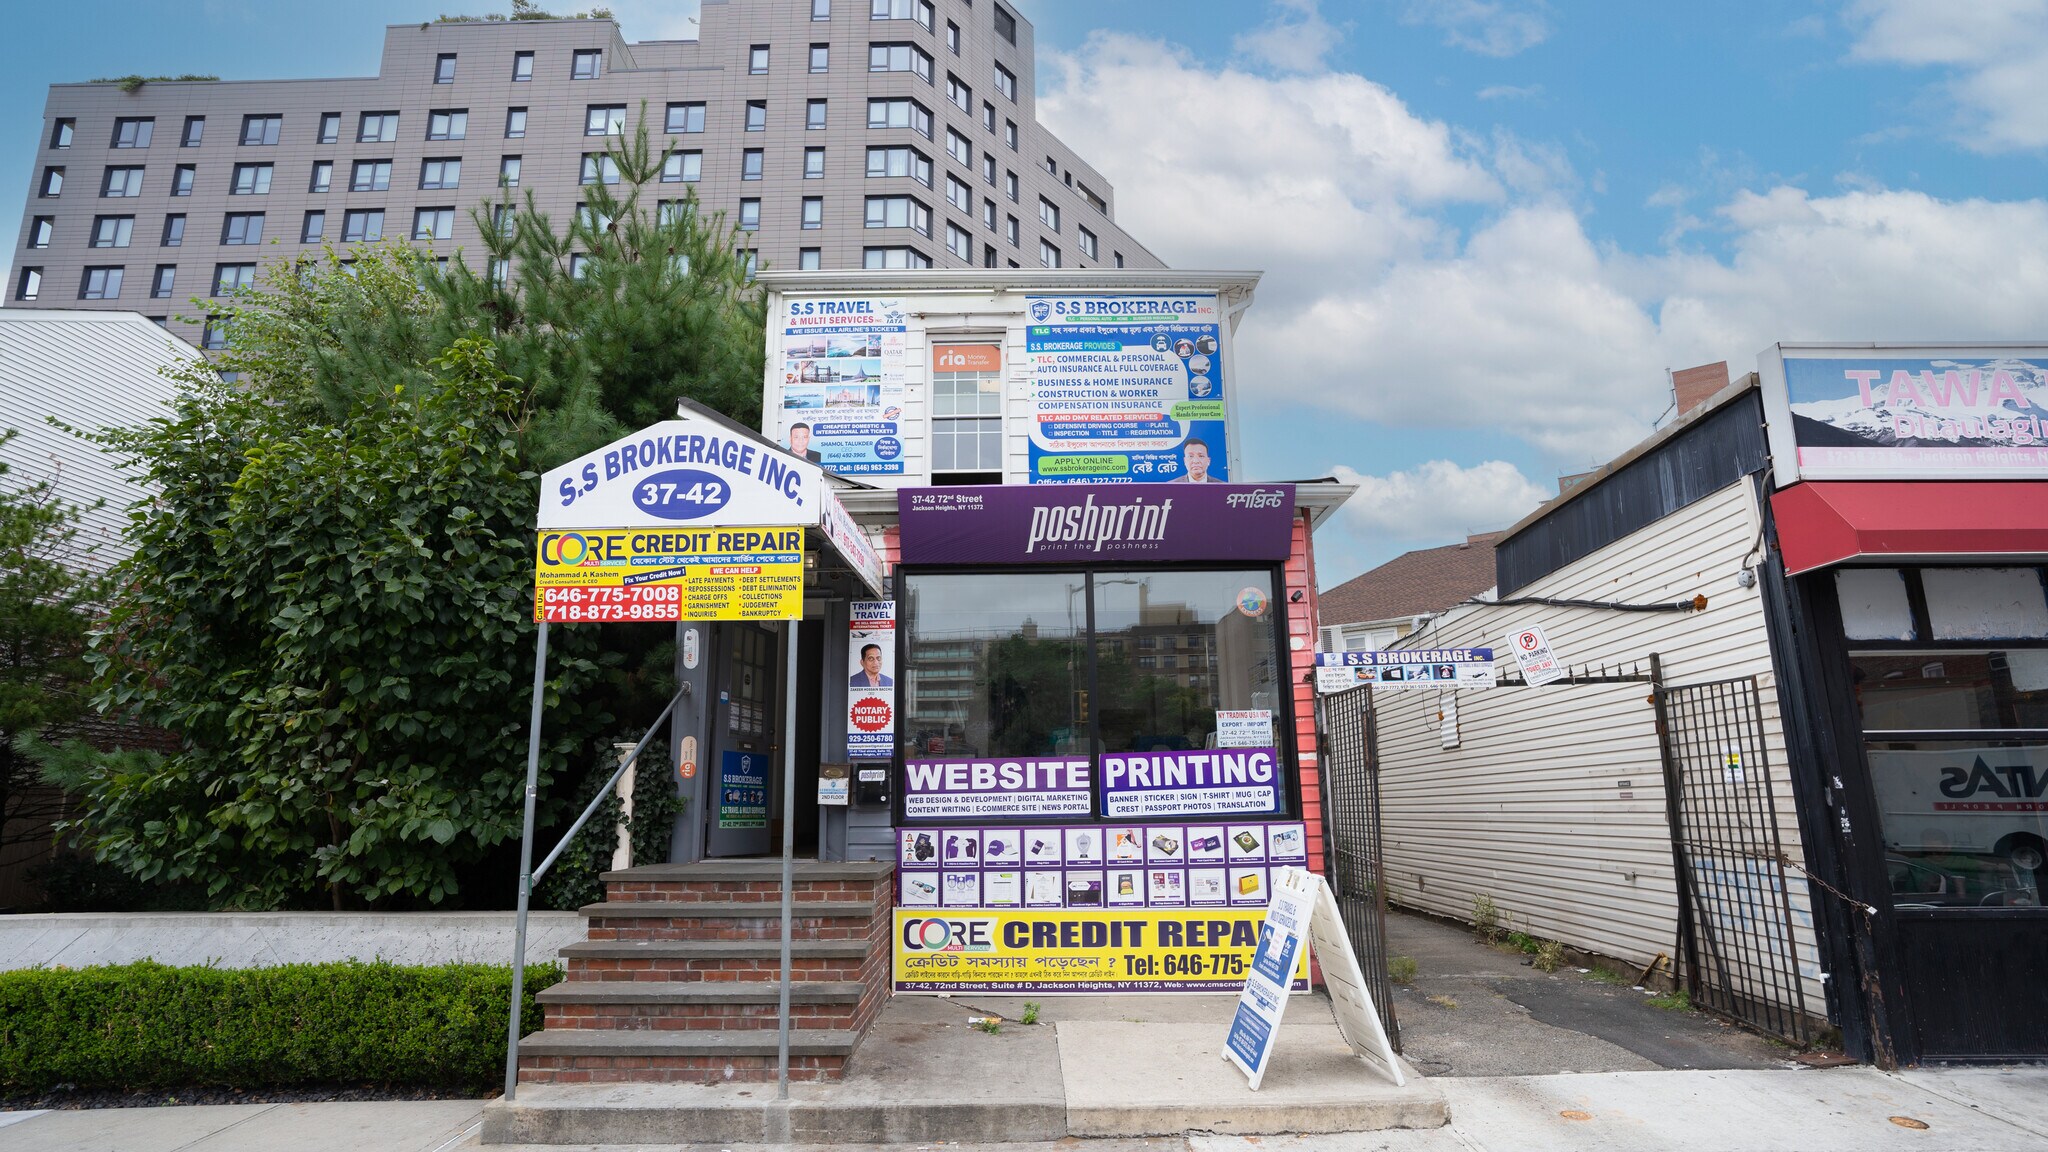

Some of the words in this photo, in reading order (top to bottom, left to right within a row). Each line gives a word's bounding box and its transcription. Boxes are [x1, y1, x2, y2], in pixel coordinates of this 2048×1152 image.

[791, 302, 814, 315] S.S
[818, 301, 873, 314] TRAVEL
[1055, 301, 1081, 315] S.S
[1085, 300, 1197, 314] BROKERAGE
[800, 316, 826, 325] MULTI
[829, 315, 874, 324] SERVICES
[1045, 342, 1083, 350] BROKERAGE
[1084, 342, 1115, 350] PROVIDES
[940, 350, 965, 366] ria
[1057, 355, 1111, 363] COMMERCIAL
[1121, 354, 1165, 362] PERSONAL
[1037, 365, 1057, 373] AUTO
[1059, 365, 1103, 373] INSURANCE
[1104, 364, 1118, 372] ALL
[1120, 364, 1138, 372] FULL
[1139, 363, 1179, 371] COVERAGE
[1037, 379, 1082, 387] BUSINESS
[1093, 378, 1119, 386] HOME
[1121, 377, 1173, 386] INSURANCE
[1038, 390, 1109, 398] CONSTRUCTION
[1119, 389, 1158, 397] WORKER
[1845, 369, 2031, 408] TAWA
[1038, 402, 1109, 410] COMPENSATION
[1111, 401, 1163, 409] INSURANCE
[559, 462, 599, 507] S.S
[604, 434, 751, 482] BROKERAGE
[757, 452, 804, 507] INC.
[1042, 464, 1127, 473] www.ssbrokerageinc.com
[641, 482, 722, 504] 37-42
[911, 495, 935, 504] 37-42
[937, 494, 955, 503] 72nd
[956, 494, 983, 503] Street
[935, 504, 957, 512] Heights,
[1025, 494, 1173, 553] poshprint
[541, 533, 628, 567] CORE
[631, 533, 711, 553] CREDIT
[717, 532, 801, 552] REPAIR
[1040, 542, 1069, 552] print
[1073, 542, 1091, 550] the
[1106, 542, 1160, 552] poshness
[545, 586, 679, 602] 646-775-7008
[852, 602, 893, 610] TRIPWAY
[544, 604, 679, 620] 718-873-9855
[1347, 653, 1373, 665] S.S
[1376, 650, 1473, 664] BROKERAGE
[1528, 647, 1548, 658] PARKING
[906, 761, 1090, 790] WEBSITE
[1105, 752, 1273, 788] PRINTING
[1046, 794, 1088, 802] MARKETING
[1144, 794, 1175, 802] STICKER
[1180, 793, 1198, 801] SIGN
[1203, 792, 1230, 800] T-SHIRT
[1062, 803, 1089, 811] PORTAL
[1145, 804, 1182, 812] PASSPORT
[1217, 801, 1266, 809] TRANSLATION
[903, 918, 992, 949] CORE
[1003, 921, 1148, 949] CREDIT
[1158, 920, 1265, 947] REPA
[905, 953, 960, 968] ক্রেডিট
[966, 957, 1028, 968] সমস্যায়
[1034, 956, 1100, 970] পড়েছেন
[1124, 955, 1159, 975] Tel:
[960, 982, 990, 990] Street,
[1037, 981, 1075, 989] Jackson
[1077, 981, 1116, 990] Heights,
[1133, 981, 1162, 989] 11372,
